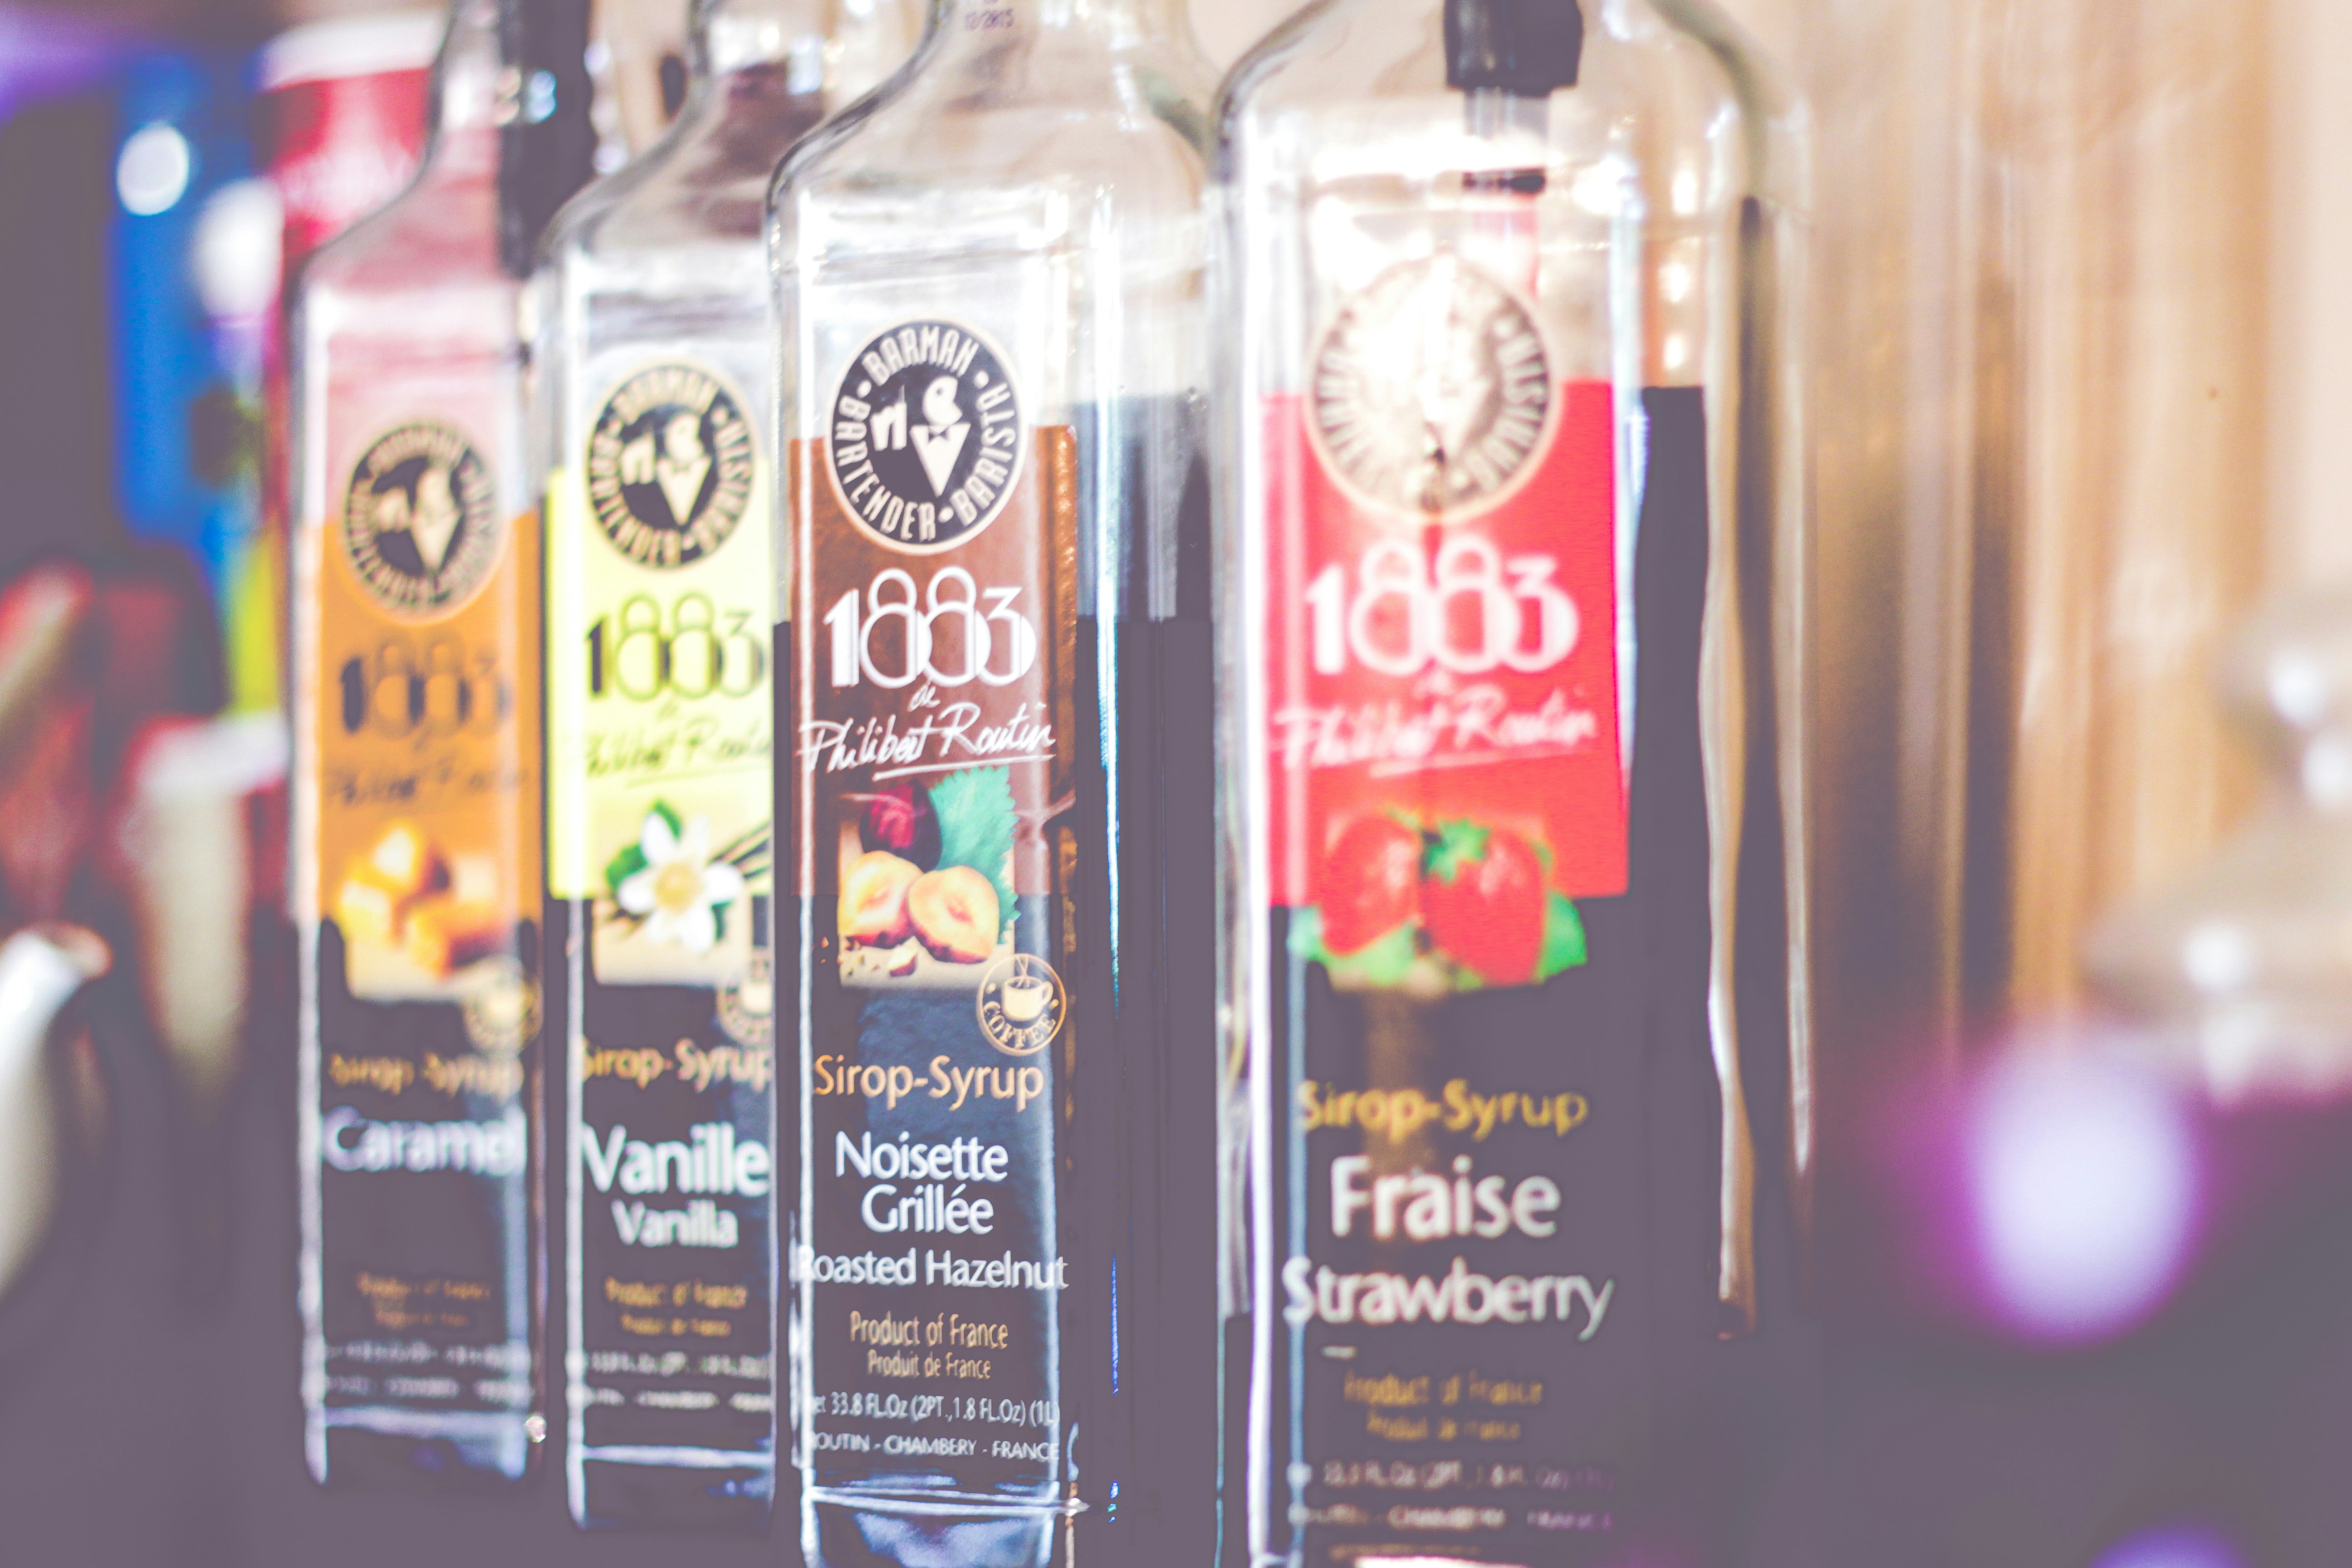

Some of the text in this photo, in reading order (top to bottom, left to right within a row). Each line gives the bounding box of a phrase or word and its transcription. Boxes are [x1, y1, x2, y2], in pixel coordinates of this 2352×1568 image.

[862, 325, 980, 387] BARMAN
[835, 395, 936, 541] BARTENDER
[949, 382, 1016, 527] BARISTA
[823, 566, 1037, 688] 1883
[1303, 535, 1581, 678] 1883
[585, 592, 765, 701] 1883
[797, 701, 1056, 773] Philibert Routin
[983, 1000, 1057, 1049] COFFEE
[813, 1054, 1044, 1112] Sirop-Syrup
[1296, 1078, 1589, 1144] Sirop-Syrup
[582, 1121, 770, 1197] Vanille
[835, 1131, 1009, 1182] Noisette
[611, 1198, 740, 1248] Vanilla
[862, 1183, 994, 1235] Grillée
[1330, 1154, 1561, 1240] Fraise
[925, 1249, 1069, 1290] Hazelnut
[1282, 1255, 1615, 1341] Strawberry
[850, 1310, 1008, 1349] Product of France
[867, 1349, 991, 1379] Produit de France
[883, 1435, 978, 1457] CHAMBERY
[991, 1440, 1060, 1464] FRANCE
